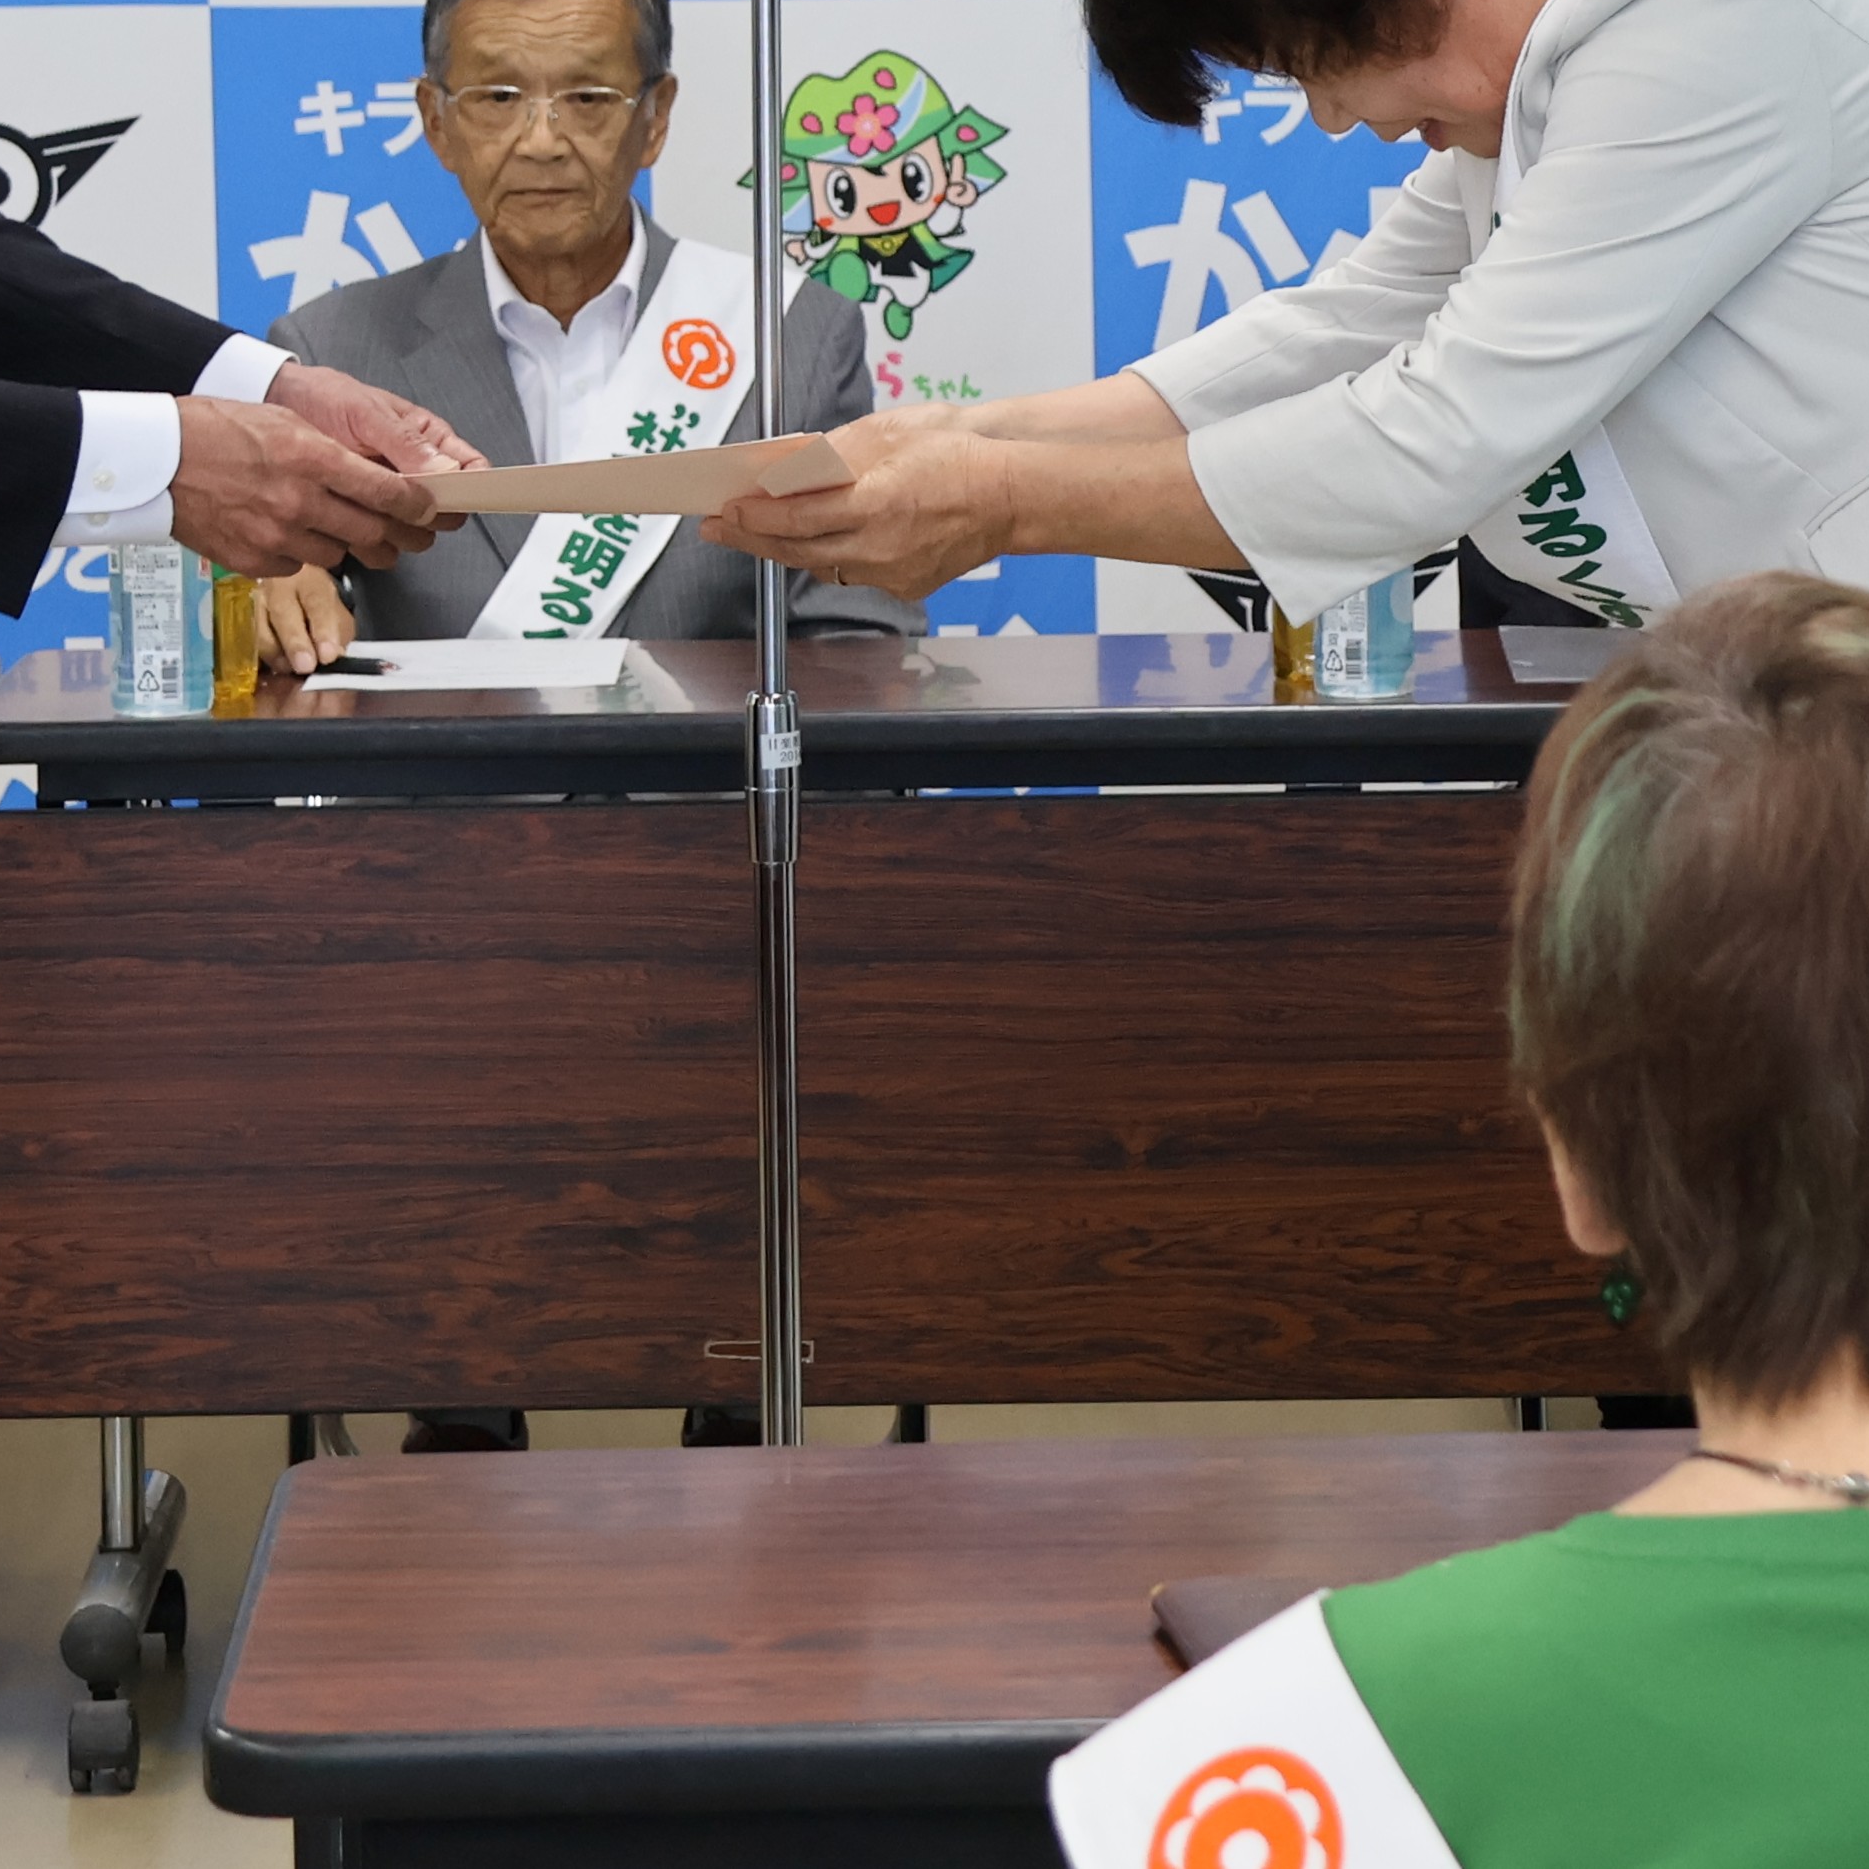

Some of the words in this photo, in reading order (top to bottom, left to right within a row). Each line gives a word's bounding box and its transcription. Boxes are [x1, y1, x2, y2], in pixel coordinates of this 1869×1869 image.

[294, 80, 426, 157] キラ
[876, 351, 982, 400] らちゃん
